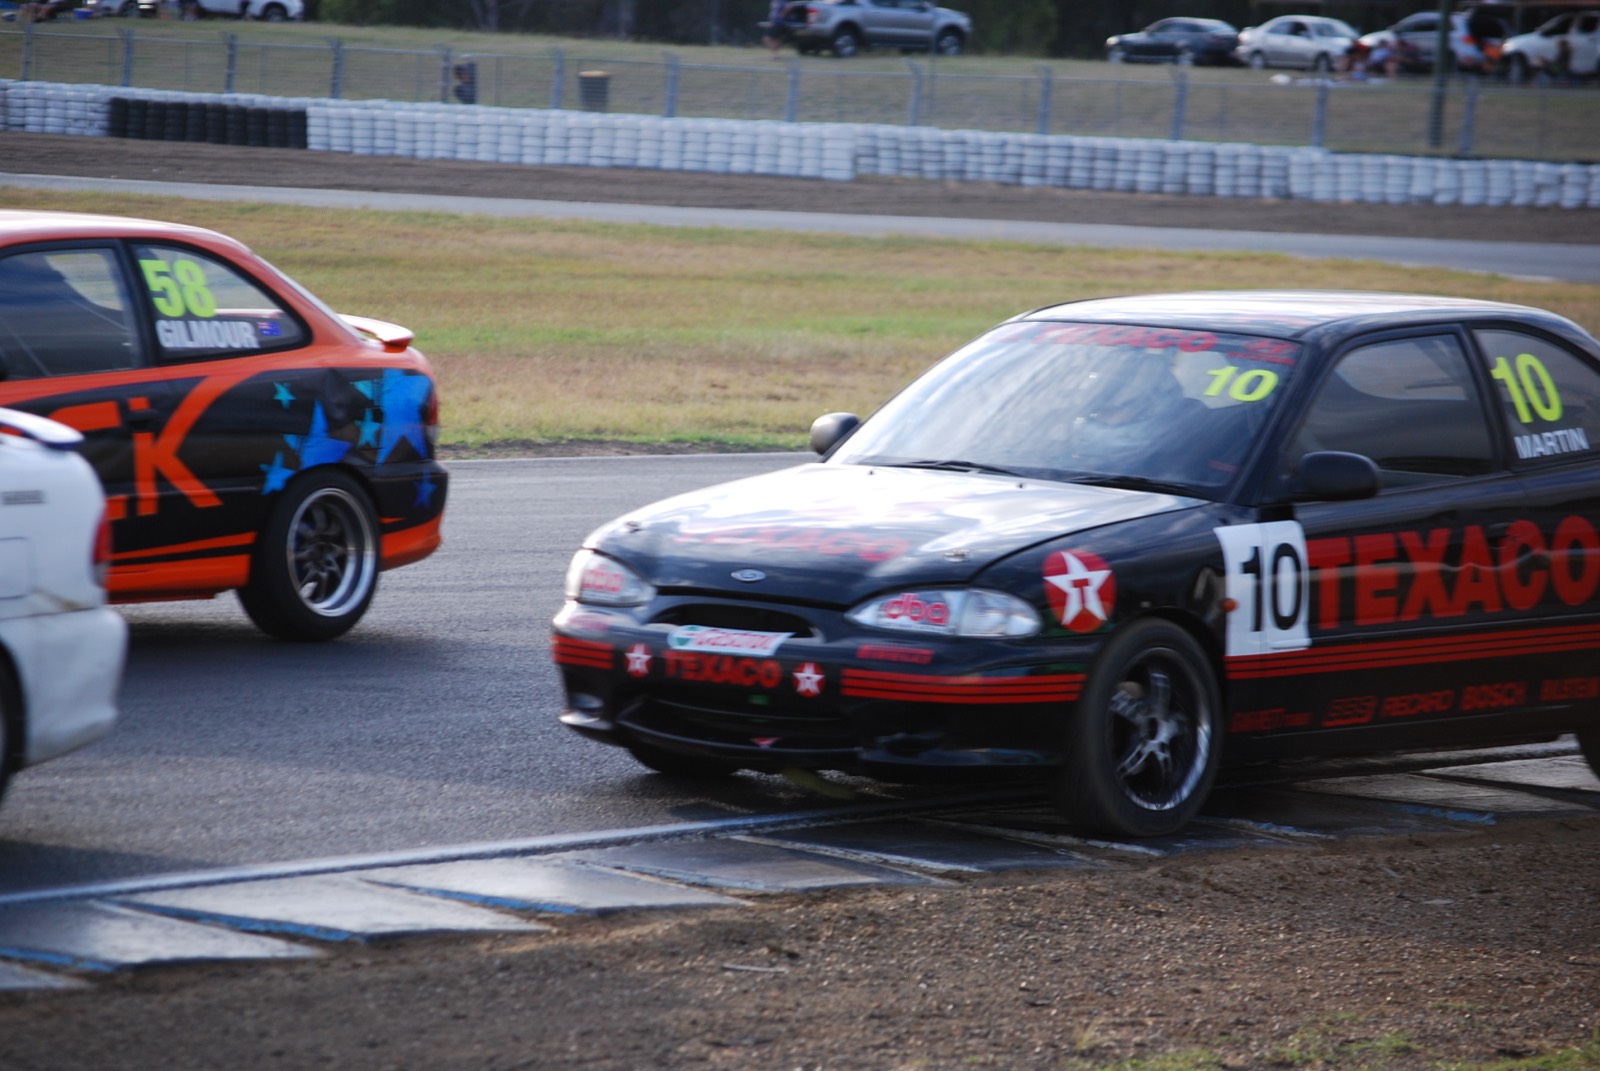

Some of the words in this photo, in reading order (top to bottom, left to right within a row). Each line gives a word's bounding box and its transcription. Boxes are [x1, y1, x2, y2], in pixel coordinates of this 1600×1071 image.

[139, 259, 217, 317] 58
[155, 319, 260, 349] GILMOUR
[1203, 366, 1279, 402] 10
[1490, 353, 1563, 423] 10
[1513, 427, 1590, 459] MARTIN
[1240, 542, 1302, 632] 10
[1305, 516, 1600, 630] TEXACO
[883, 592, 950, 625] dba
[661, 650, 782, 688] TEXACO
[1461, 681, 1530, 711] BOSCH
